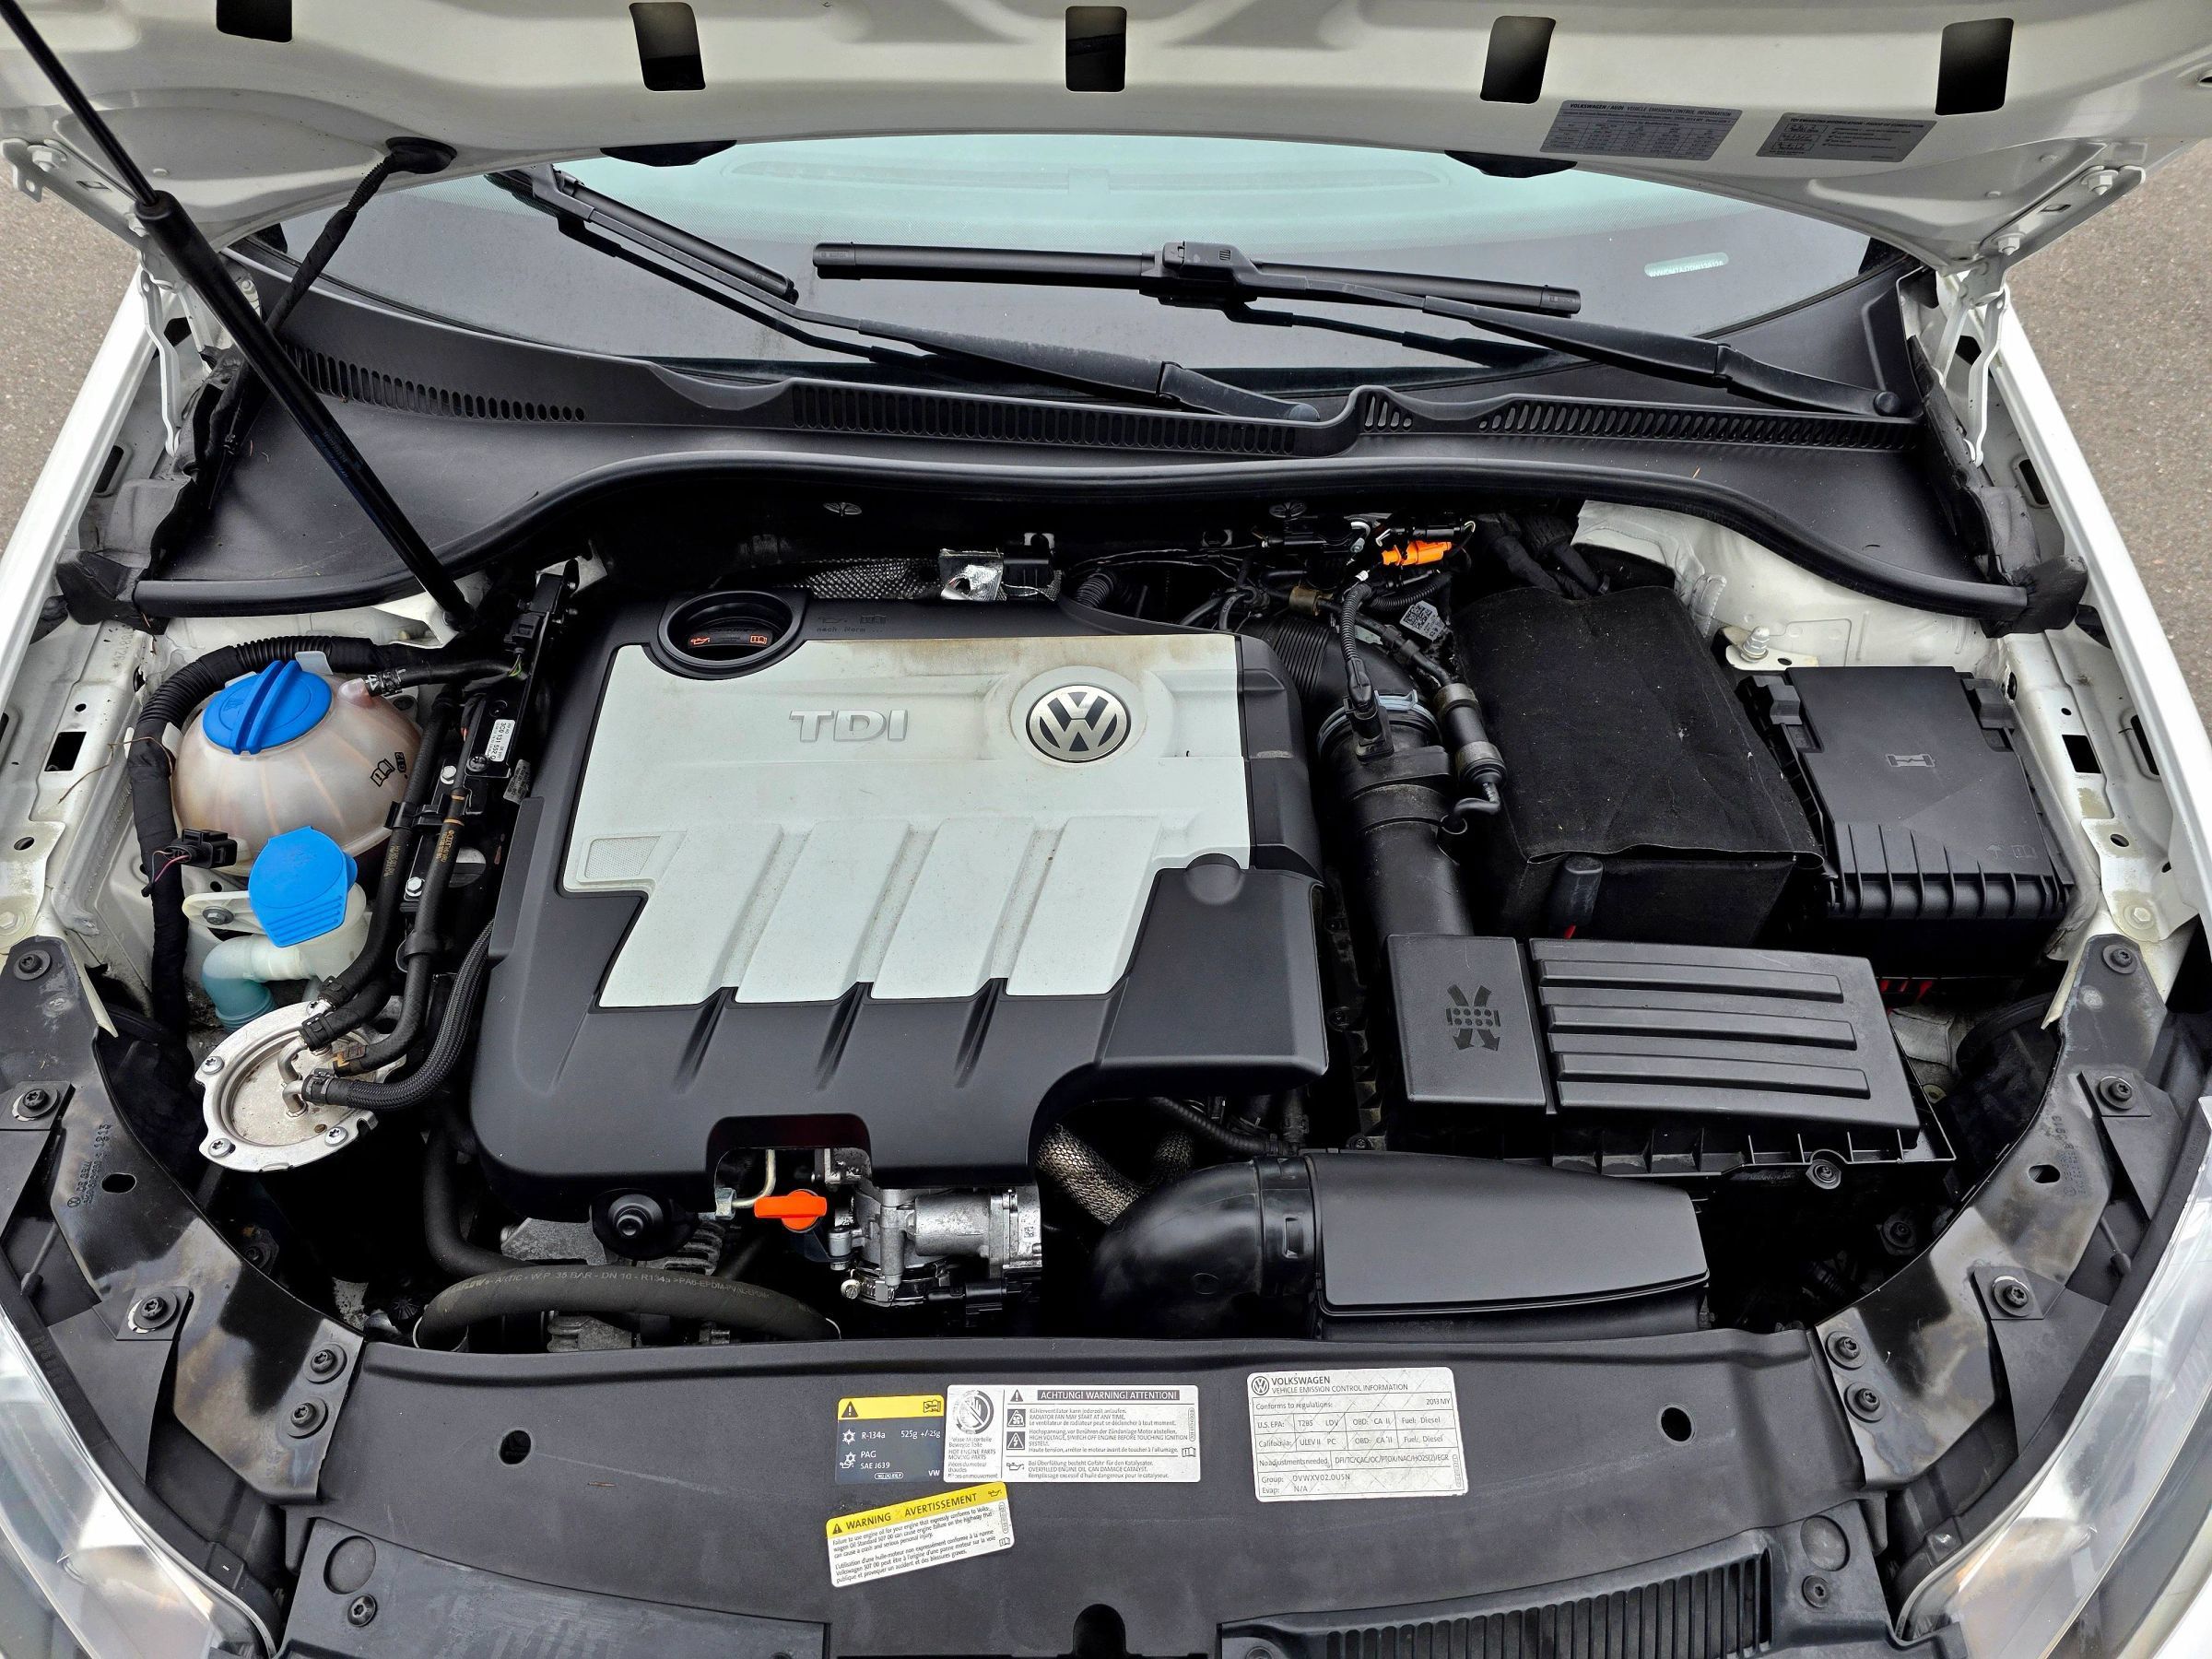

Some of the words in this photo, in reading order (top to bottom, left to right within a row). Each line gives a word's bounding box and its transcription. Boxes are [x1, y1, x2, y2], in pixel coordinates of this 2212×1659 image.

[789, 710, 907, 743] TDI
[1270, 1375, 1331, 1385] VOLKSWAGEN
[1271, 1386, 1298, 1394] VEHICLE
[1299, 1385, 1331, 1394] EMISSION
[1362, 1382, 1408, 1391] INFORMATION
[1041, 1391, 1084, 1399] ACHTUNG!
[1085, 1391, 1128, 1399] WARNING!
[1129, 1391, 1177, 1399] ATTENTION!
[1255, 1402, 1287, 1410] Conforms
[1295, 1400, 1333, 1409] regulations:
[1352, 1418, 1369, 1426] OBD:
[862, 1431, 886, 1440] R-134a
[901, 1430, 918, 1439] 525g
[920, 1429, 941, 1438] +/-25g
[1403, 1434, 1420, 1443] Fuel:
[1421, 1434, 1444, 1442] Diesel
[1300, 1438, 1314, 1446] ULEV
[1258, 1459, 1269, 1467] No
[1267, 1457, 1306, 1468] adjustments
[1305, 1456, 1330, 1465] needed.
[1261, 1475, 1284, 1486] Group:
[1262, 1486, 1280, 1496] Evap:
[904, 1492, 977, 1517] AVERTISSEMENT
[845, 1512, 891, 1530] WARNING
[929, 1514, 949, 1524] expressly
[950, 1511, 971, 1519] conforms
[856, 1536, 877, 1547] Standard
[916, 1525, 932, 1534] engine
[962, 1514, 982, 1524] highway
[982, 1510, 992, 1518] that
[883, 1539, 900, 1547] serious
[900, 1534, 918, 1544] personal
[947, 1535, 968, 1545] conforme
[835, 1566, 863, 1576] Volkswagen
[880, 1559, 891, 1567] peut
[907, 1551, 925, 1559] l'origine
[939, 1546, 954, 1554] panne
[836, 1572, 856, 1583] publique
[864, 1567, 887, 1578] provoquer
[895, 1560, 914, 1570] accident
[929, 1552, 950, 1561] blessures
